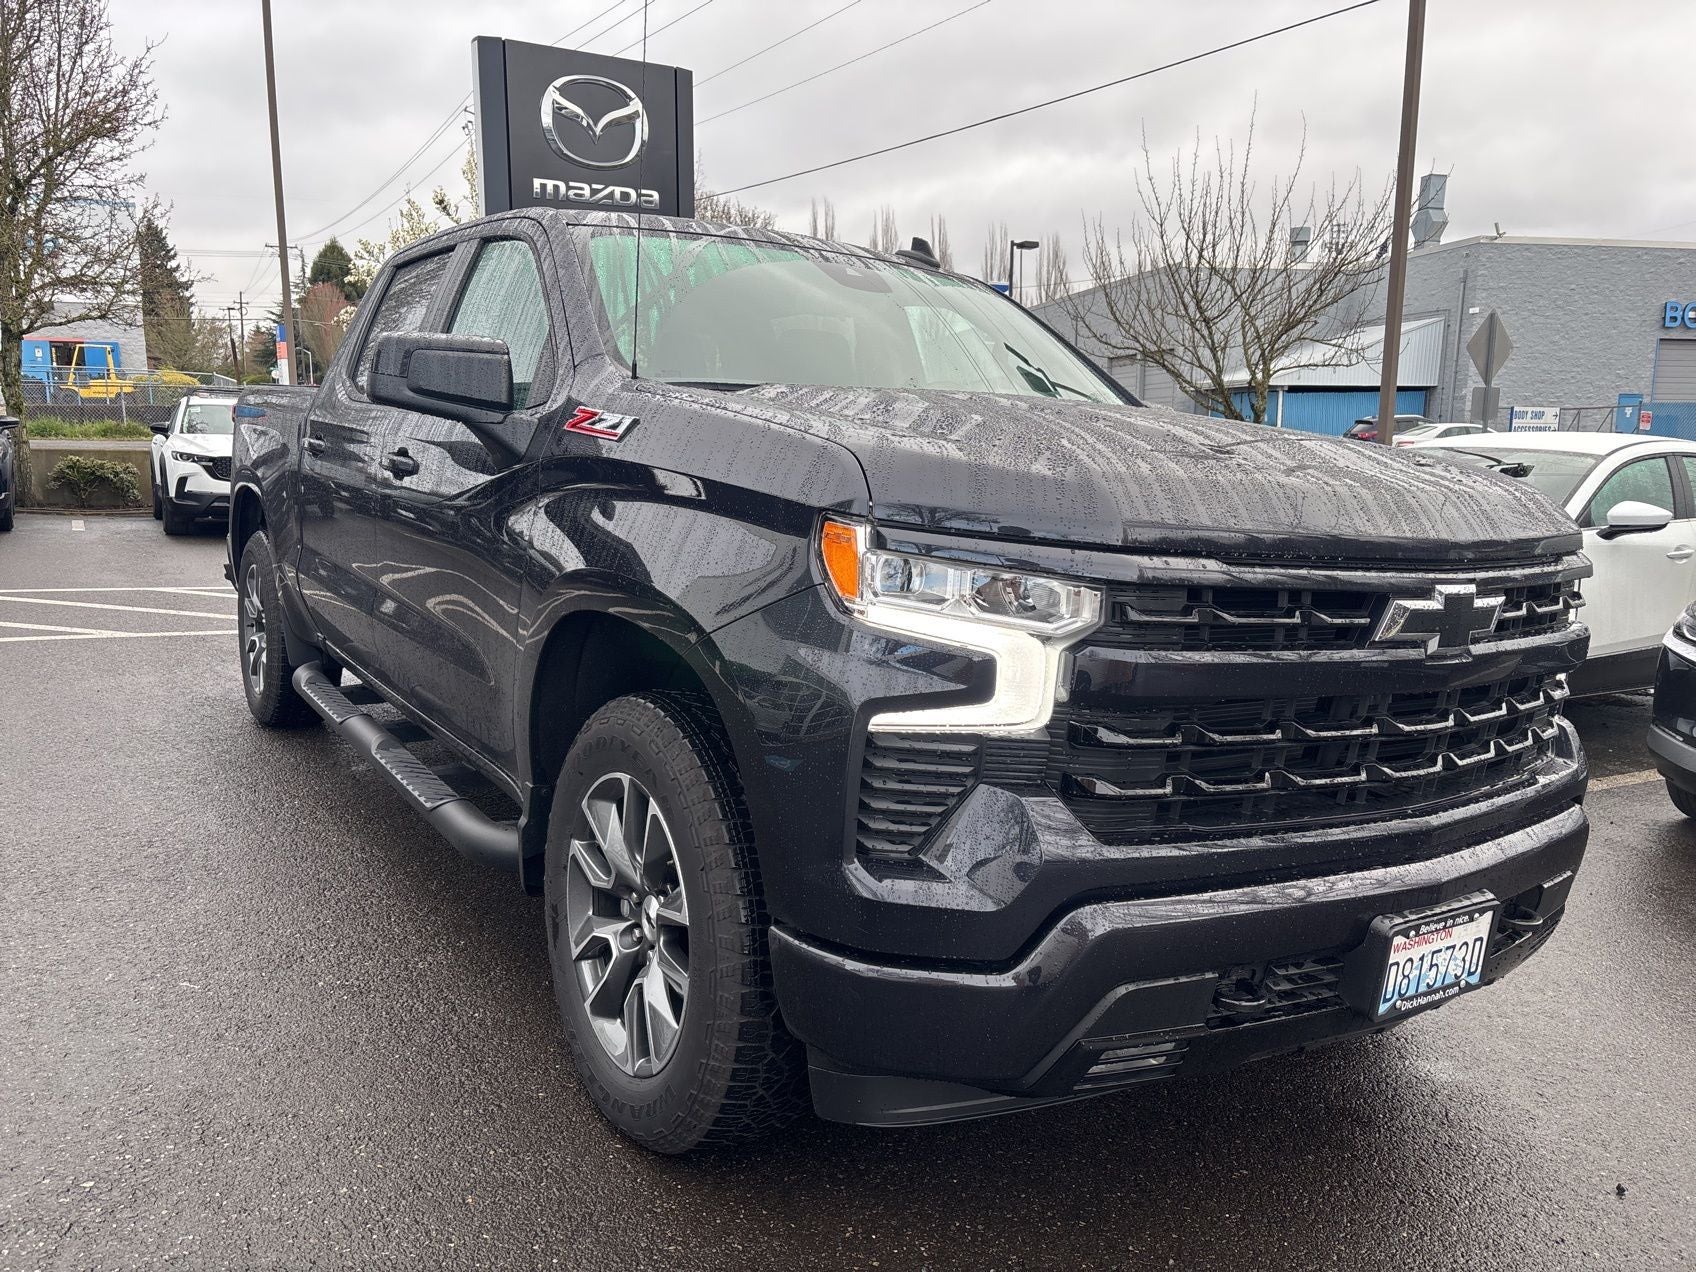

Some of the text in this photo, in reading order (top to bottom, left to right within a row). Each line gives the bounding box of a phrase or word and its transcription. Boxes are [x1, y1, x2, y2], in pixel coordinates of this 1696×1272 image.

[564, 405, 640, 441] Z71
[1513, 410, 1545, 420] BODY SHOP
[1419, 922, 1444, 934] Believe
[1393, 929, 1453, 953] WASHINGTON
[1382, 936, 1484, 1004] D81573D
[1401, 986, 1460, 1011] DickHannah.com
